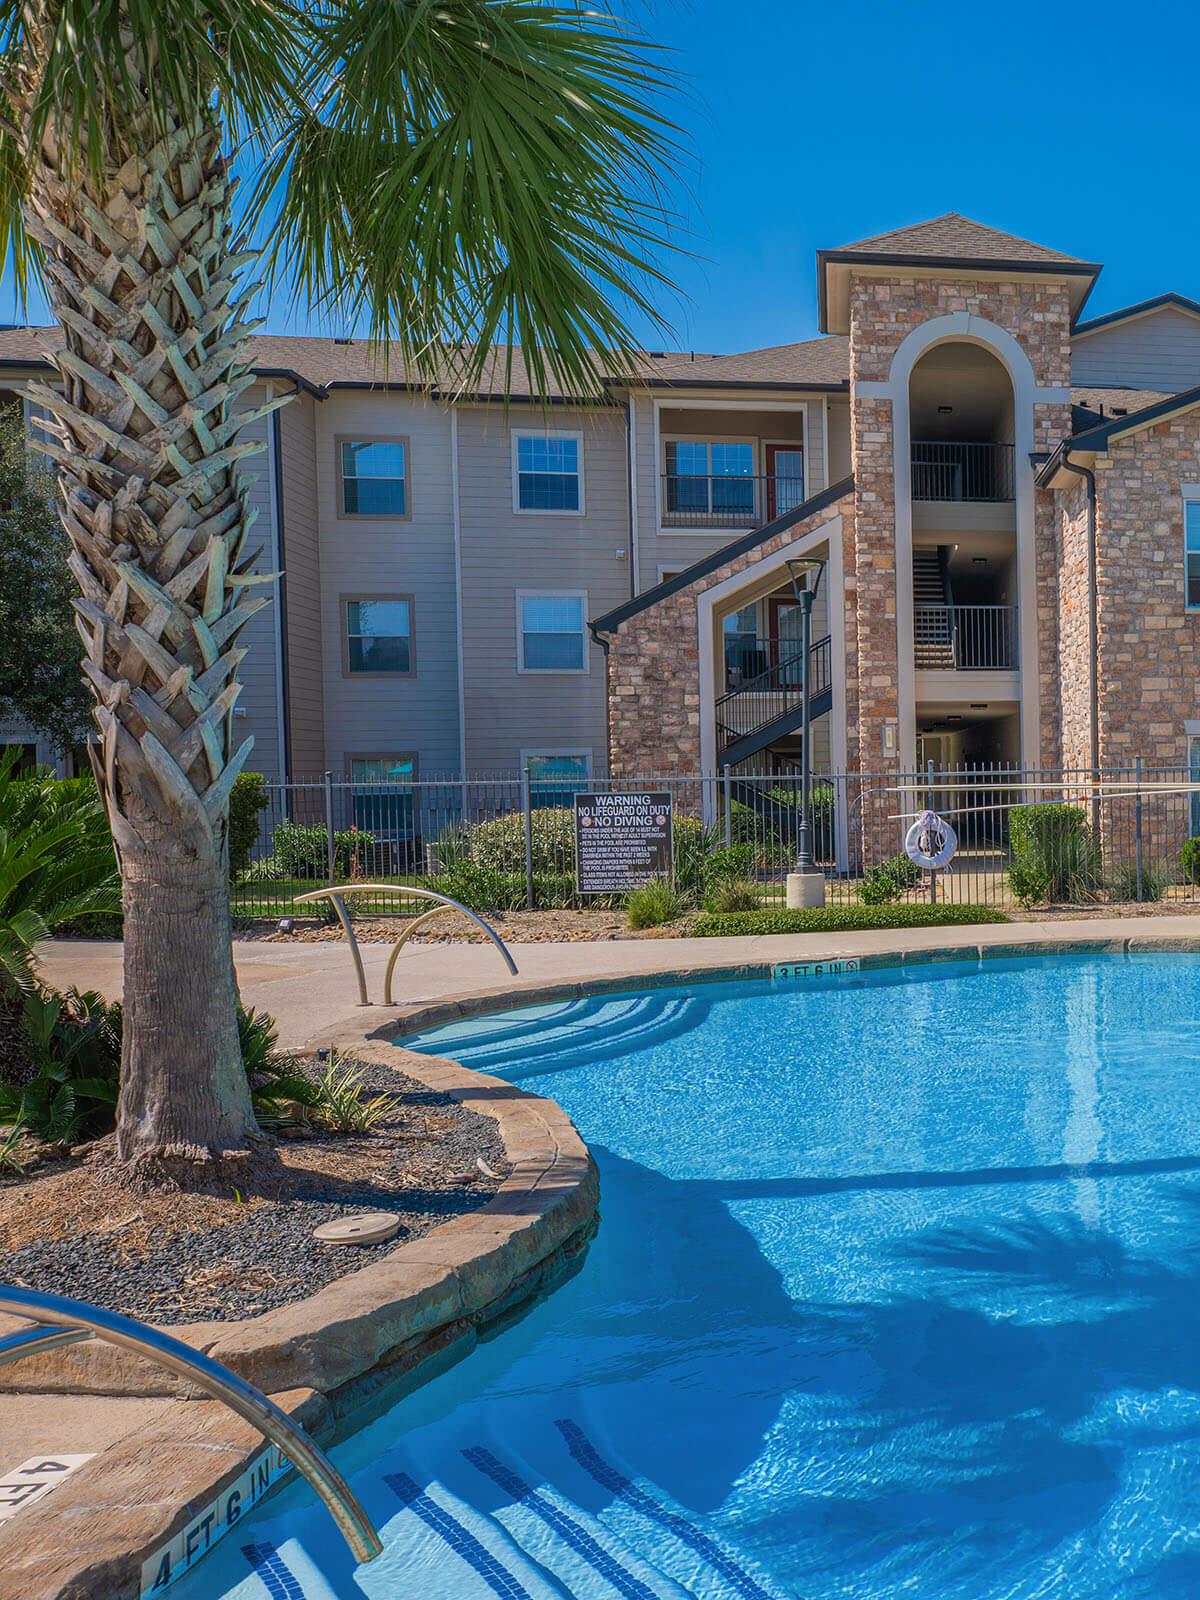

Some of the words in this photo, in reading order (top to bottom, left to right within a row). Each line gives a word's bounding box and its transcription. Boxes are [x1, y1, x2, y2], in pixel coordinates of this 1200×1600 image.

[595, 795, 651, 806] WARNING
[579, 807, 590, 816] NO
[592, 806, 635, 816] LIFEGUARD
[636, 806, 648, 815] ON
[649, 805, 670, 815] DUTY
[594, 816, 611, 826] NO
[614, 815, 653, 826] DIVING
[780, 968, 788, 976] 3
[815, 965, 823, 975] 6
[829, 963, 841, 973] IN
[152, 1552, 172, 1592] 4
[186, 1511, 215, 1565] FT
[226, 1490, 241, 1525] 6
[251, 1457, 270, 1502] IN
